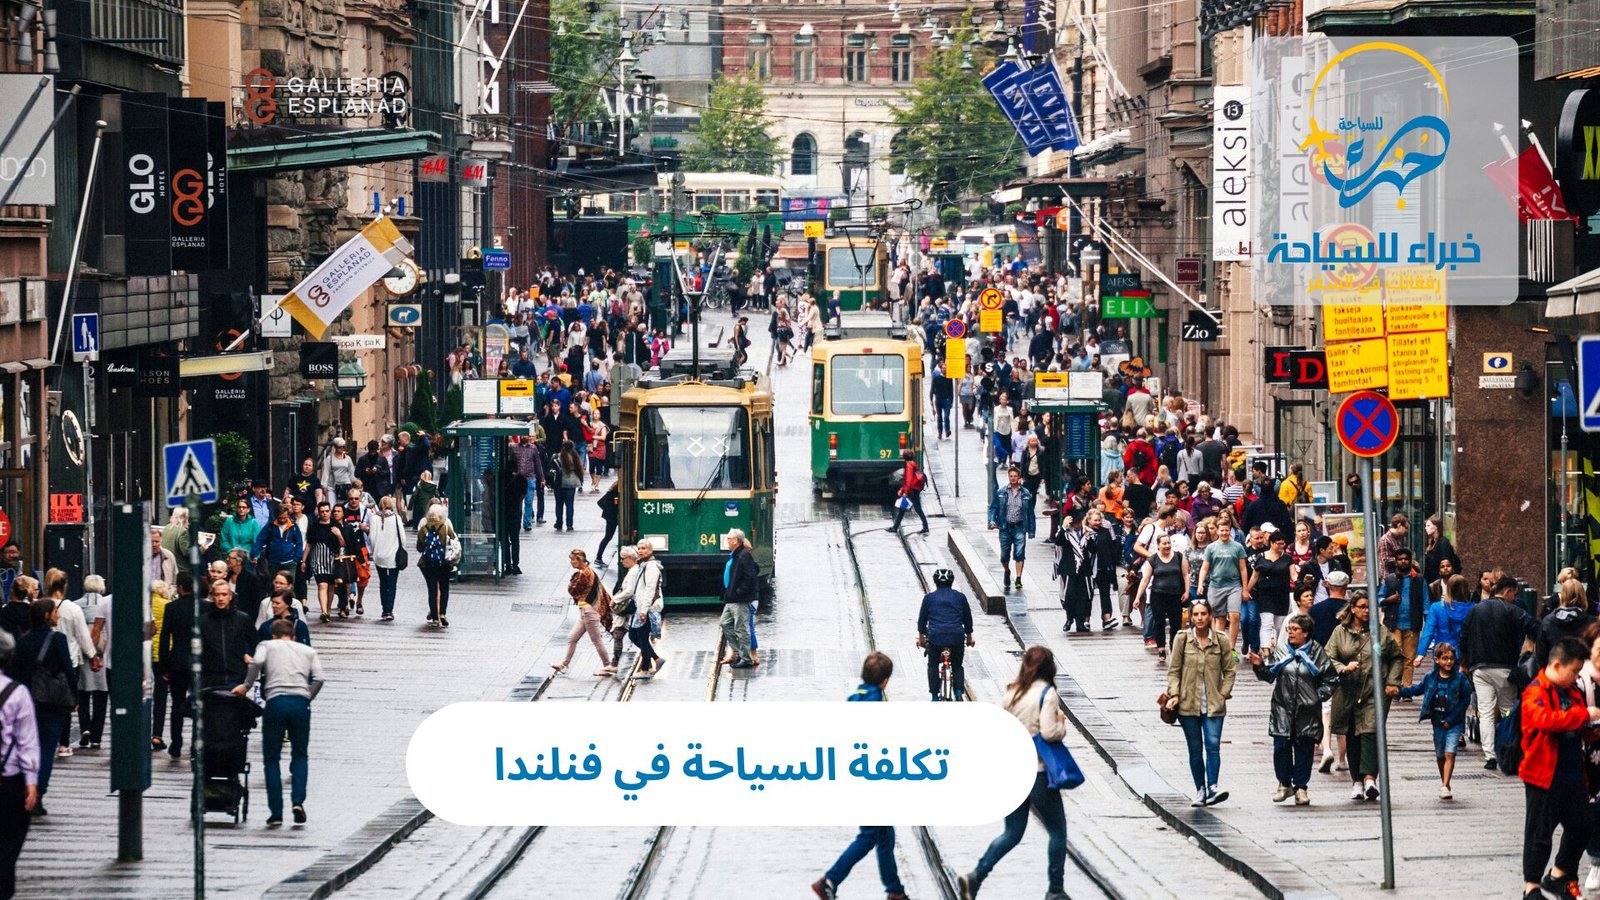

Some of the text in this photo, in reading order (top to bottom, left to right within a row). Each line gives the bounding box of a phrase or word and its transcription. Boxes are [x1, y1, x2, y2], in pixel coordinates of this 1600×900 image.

[288, 77, 405, 93] GALLERIA
[289, 97, 406, 114] ESPLANAD
[1033, 82, 1067, 131] EVLI
[1227, 105, 1239, 116] 13
[129, 153, 155, 214] GLO
[1215, 127, 1247, 227] aleksi
[485, 254, 508, 262] Fenno
[1215, 245, 1241, 257] aleks
[322, 246, 367, 284] GALLERIA
[326, 250, 371, 289] ESPLANAD
[1334, 306, 1361, 314] takseja
[1183, 324, 1209, 339] Zio
[1392, 349, 1417, 357] stanna
[308, 363, 334, 372] BOSS
[985, 362, 993, 372] S
[1297, 357, 1324, 383] D
[879, 449, 892, 459] 97
[700, 533, 717, 546] 84
